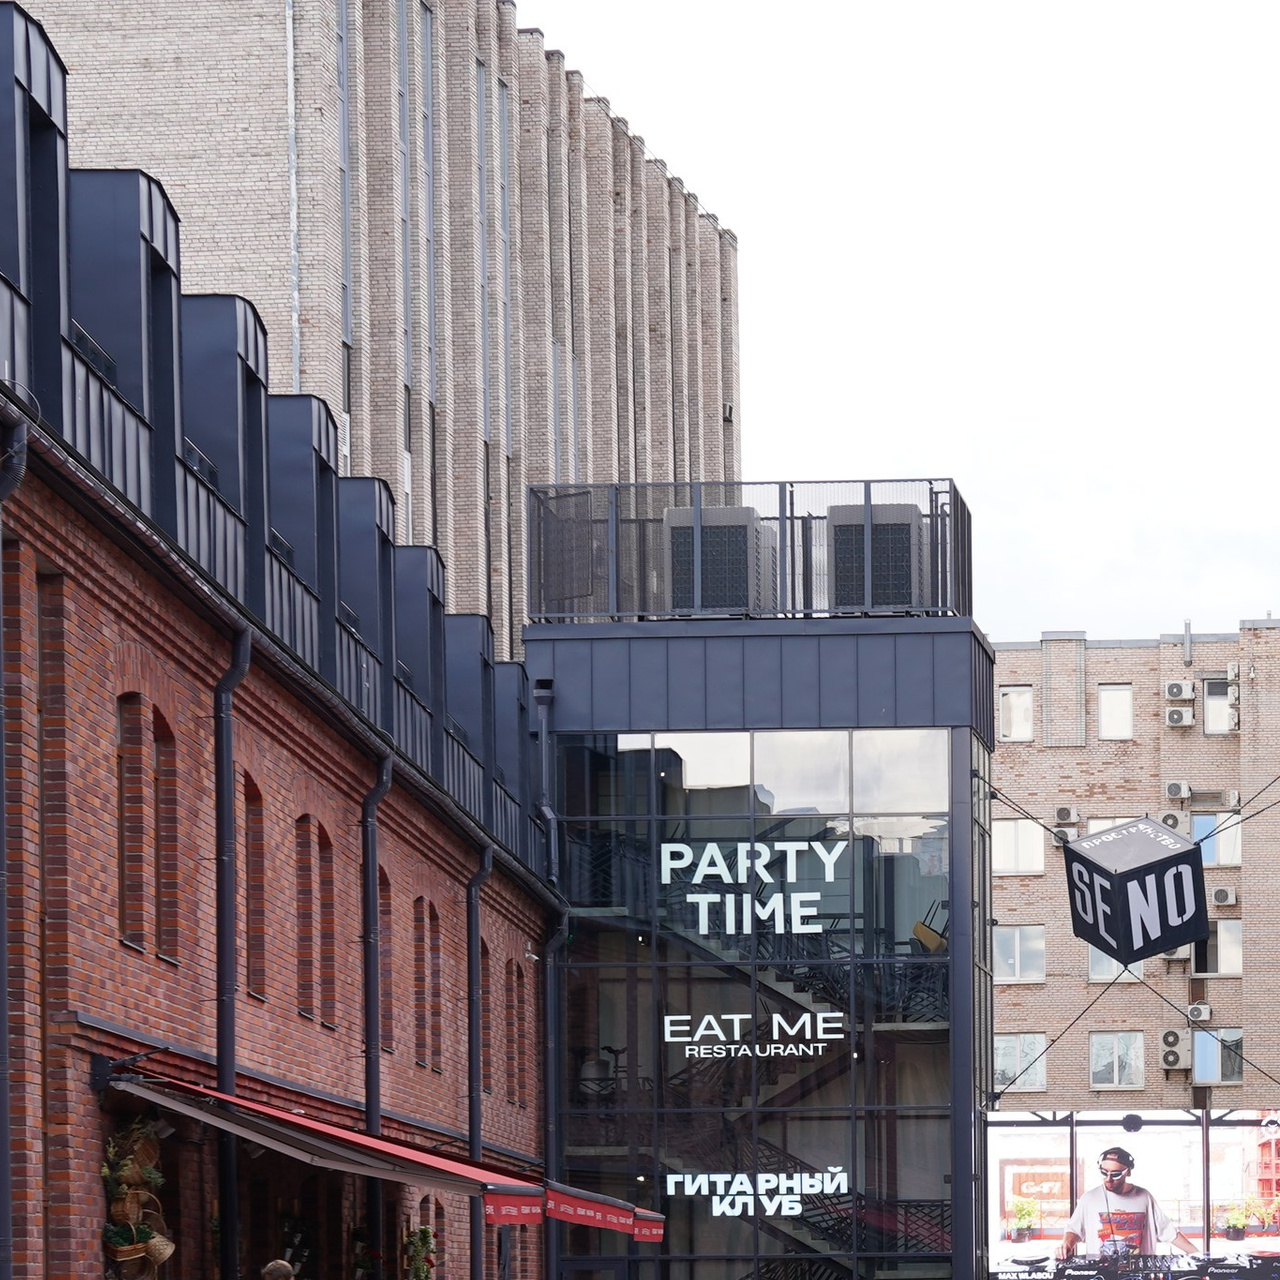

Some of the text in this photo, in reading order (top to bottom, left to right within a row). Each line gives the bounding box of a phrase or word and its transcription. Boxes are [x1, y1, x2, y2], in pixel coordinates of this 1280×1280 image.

[1081, 823, 1182, 850] ПРОСТРАНСТВО
[661, 840, 848, 884] PARTY
[686, 891, 823, 935] TIME
[663, 1012, 845, 1043] EAT ME
[684, 1043, 827, 1059] RESTAURANT
[666, 1166, 849, 1196] ГИТАРНЫЙ
[712, 1194, 803, 1218] КЛУБ
[998, 1272, 1018, 1280] MAX
